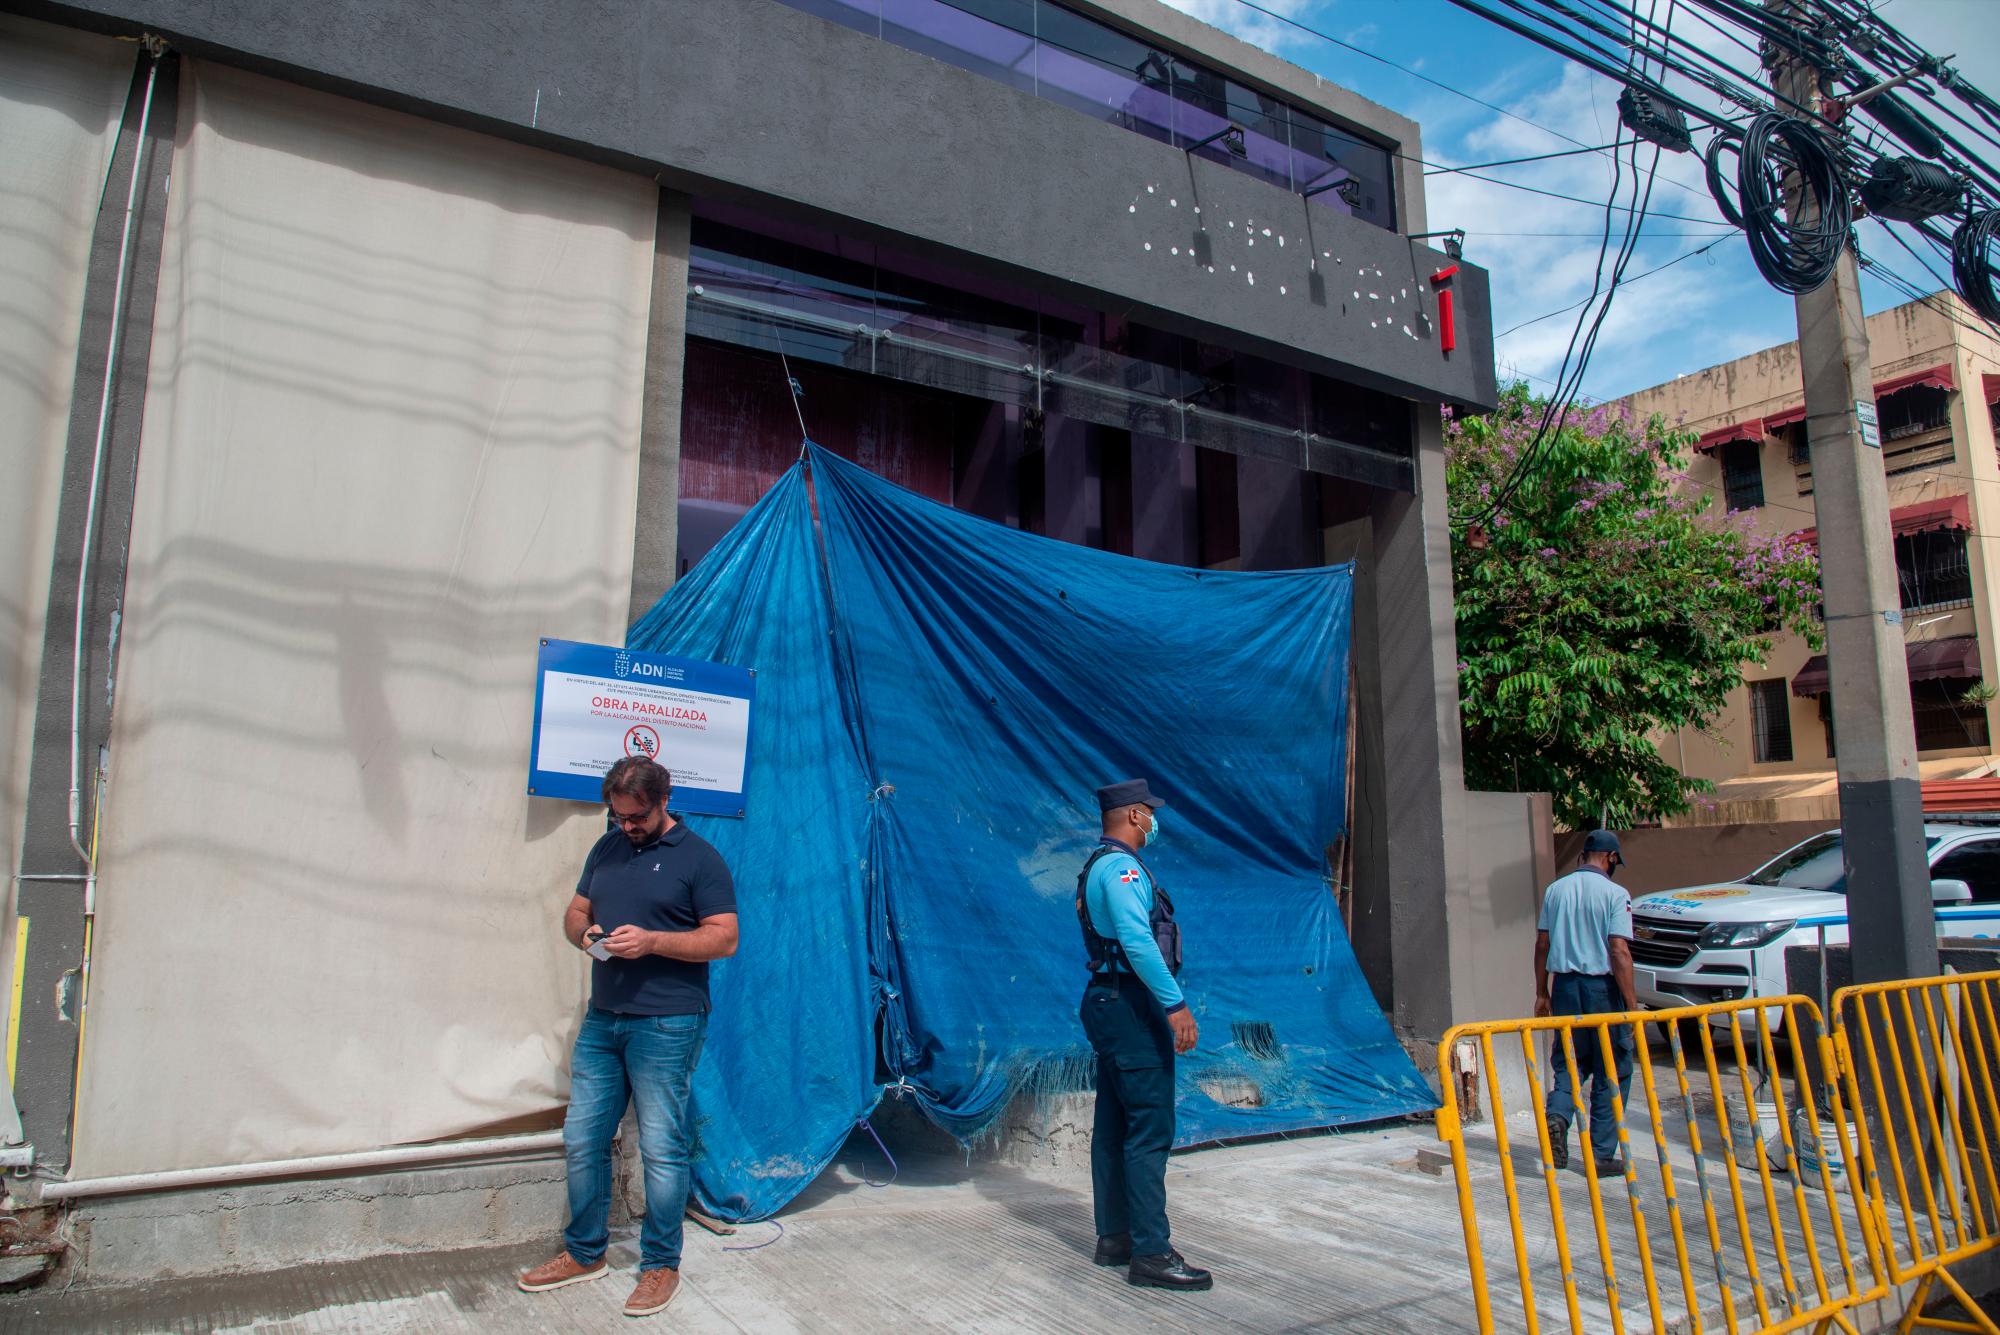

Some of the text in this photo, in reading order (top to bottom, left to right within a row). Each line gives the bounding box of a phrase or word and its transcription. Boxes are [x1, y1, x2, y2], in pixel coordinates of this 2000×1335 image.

[631, 661, 663, 677] ADN
[590, 709, 602, 717] POR
[603, 710, 612, 718] LA
[640, 715, 651, 723] DEL
[652, 717, 676, 726] DISTRITO
[677, 720, 706, 730] NACIONAL
[591, 696, 707, 722] OBRA PARALIZADA
